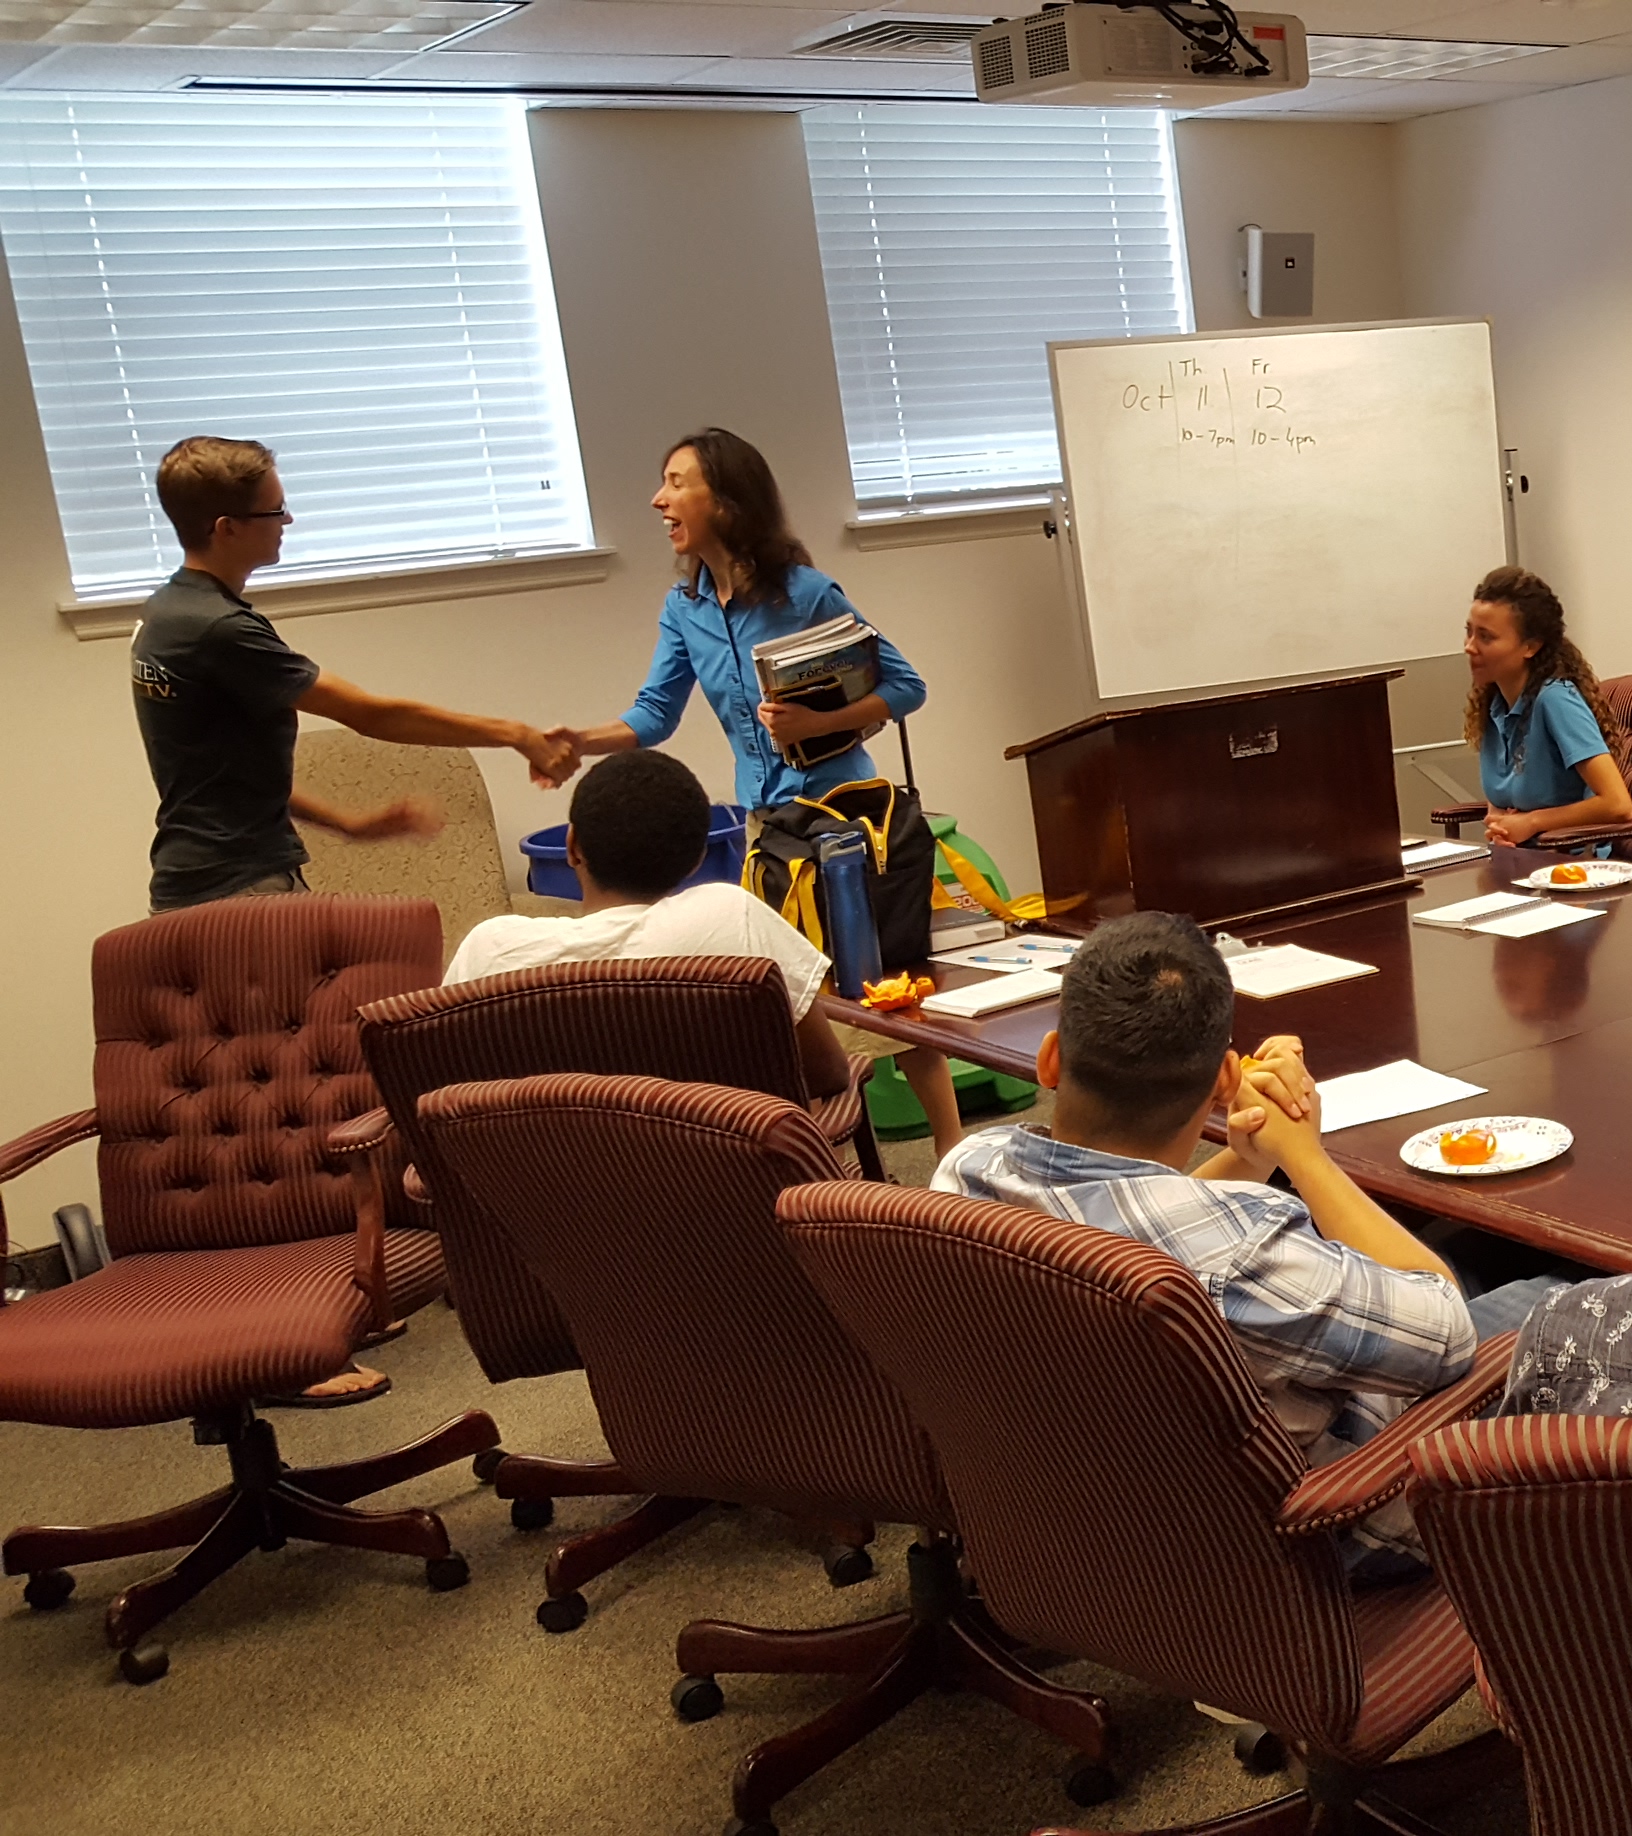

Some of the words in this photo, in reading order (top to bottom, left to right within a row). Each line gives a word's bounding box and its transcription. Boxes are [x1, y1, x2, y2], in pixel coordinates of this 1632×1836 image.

[1179, 358, 1203, 377] Th
[1252, 357, 1271, 375] Fr
[1123, 384, 1173, 411] Oct
[1197, 385, 1208, 411] 11
[1256, 385, 1287, 413] 12
